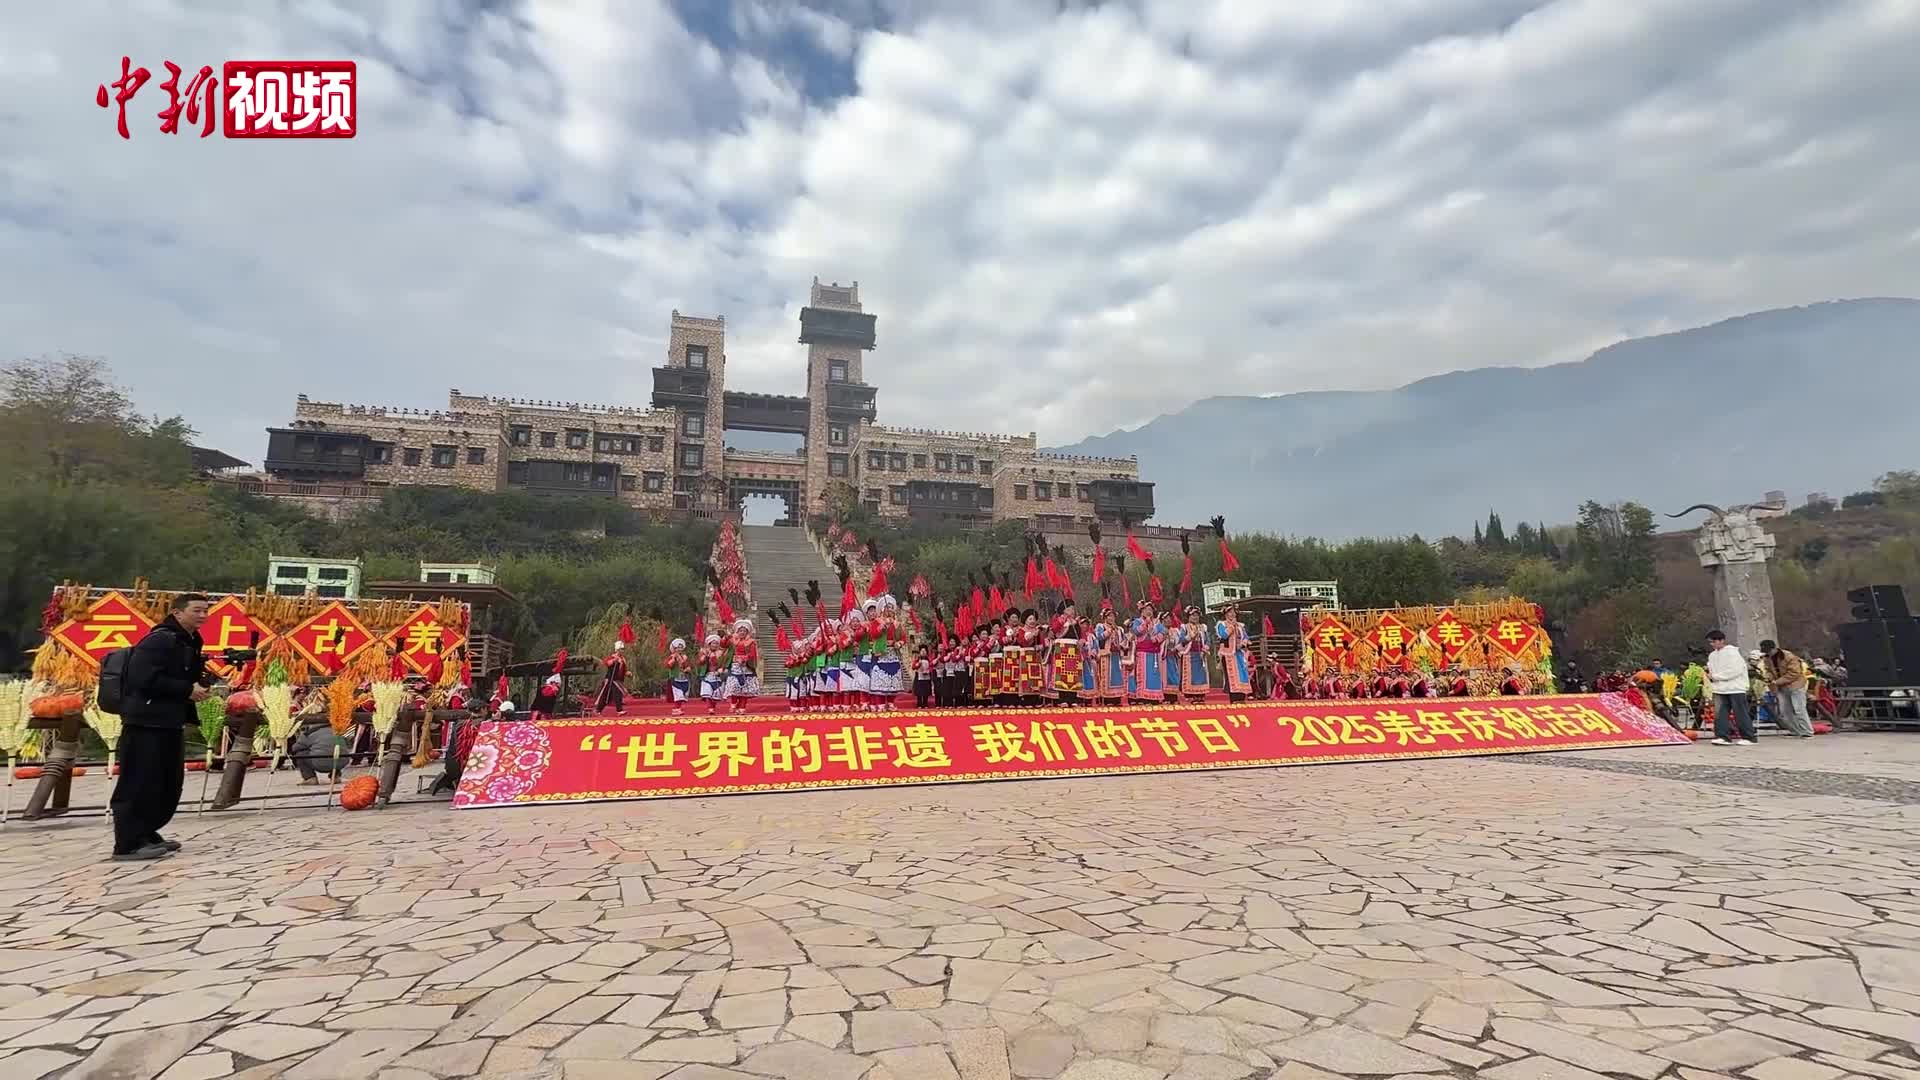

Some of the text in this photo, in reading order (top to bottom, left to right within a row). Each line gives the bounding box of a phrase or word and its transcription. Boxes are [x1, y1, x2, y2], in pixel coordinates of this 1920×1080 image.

[1278, 704, 1622, 746] 2025羌年庆祝活动
